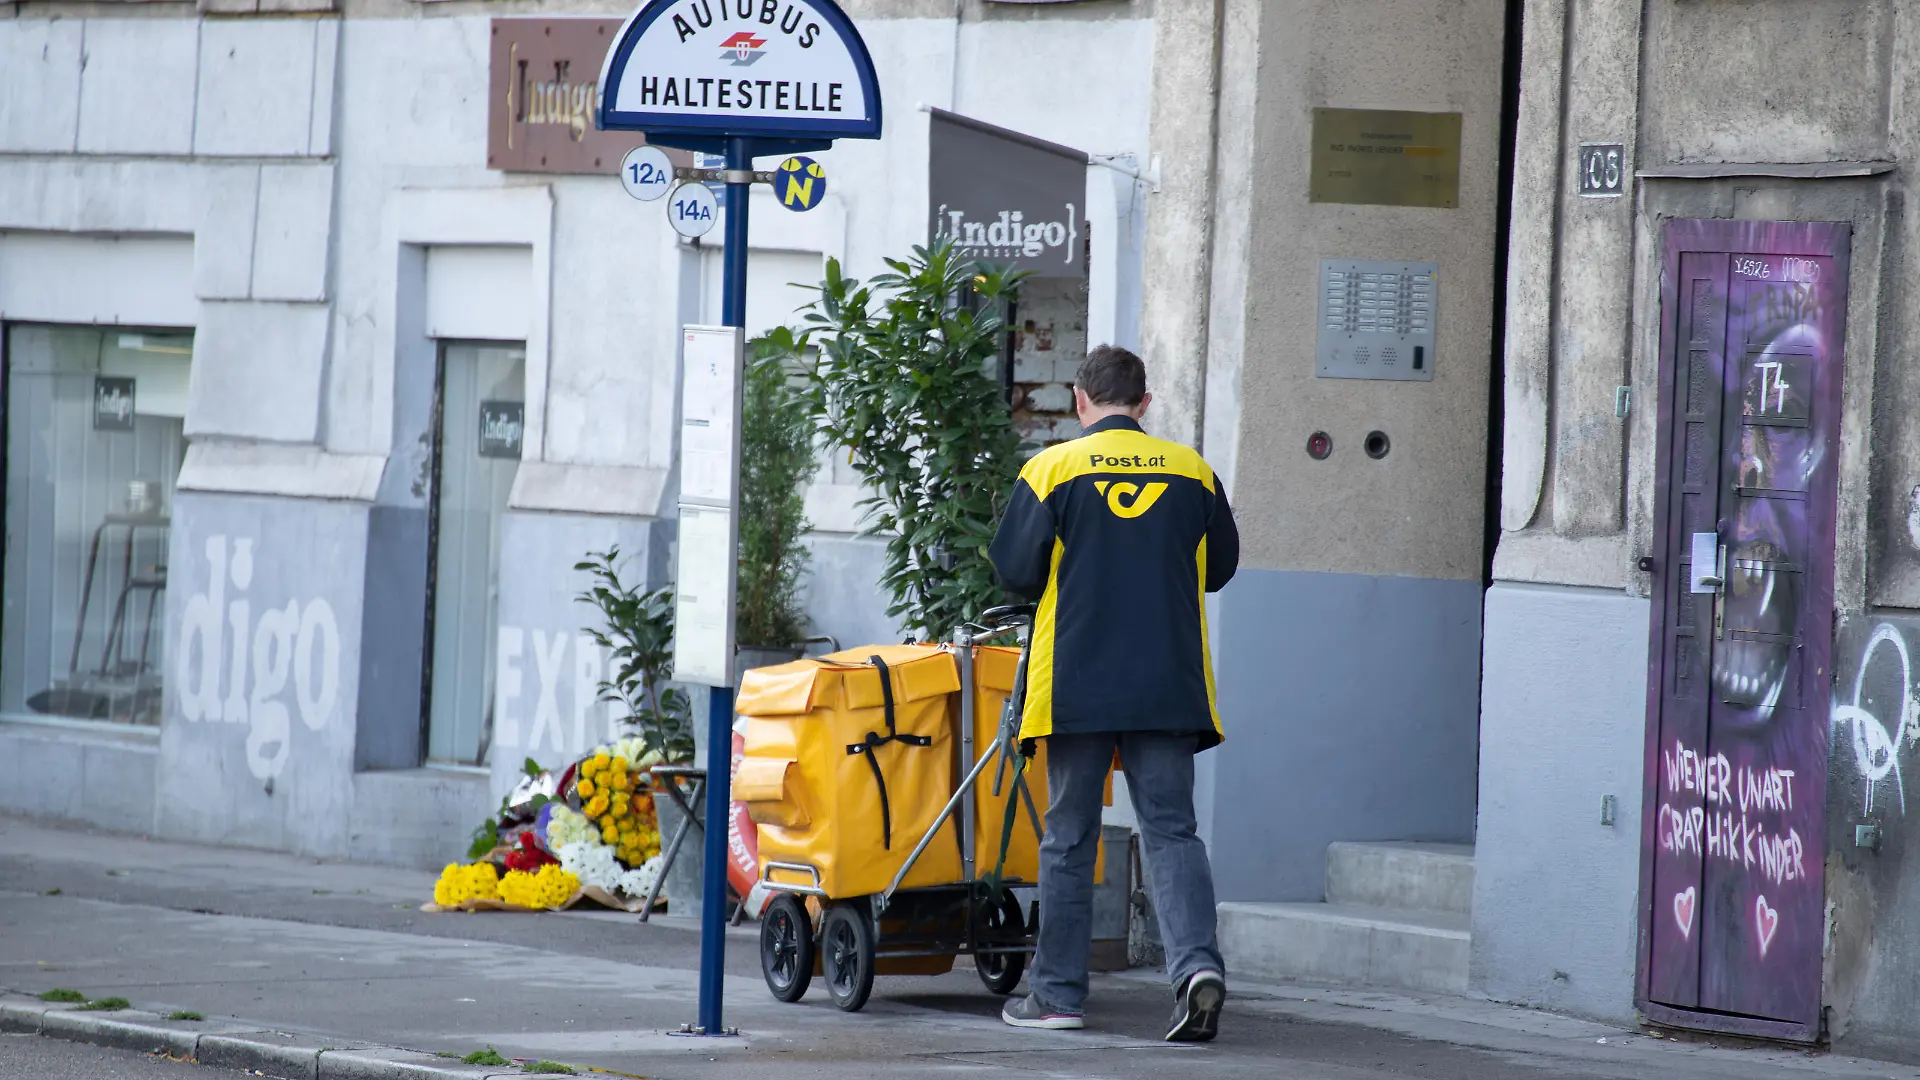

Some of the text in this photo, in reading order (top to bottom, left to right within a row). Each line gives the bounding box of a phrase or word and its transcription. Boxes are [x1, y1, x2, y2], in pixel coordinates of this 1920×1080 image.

[641, 76, 842, 112] HALTESTELLE
[629, 163, 666, 185] 12A
[784, 174, 813, 209] N
[675, 199, 711, 221] 14A
[1090, 454, 1166, 467] Post.at
